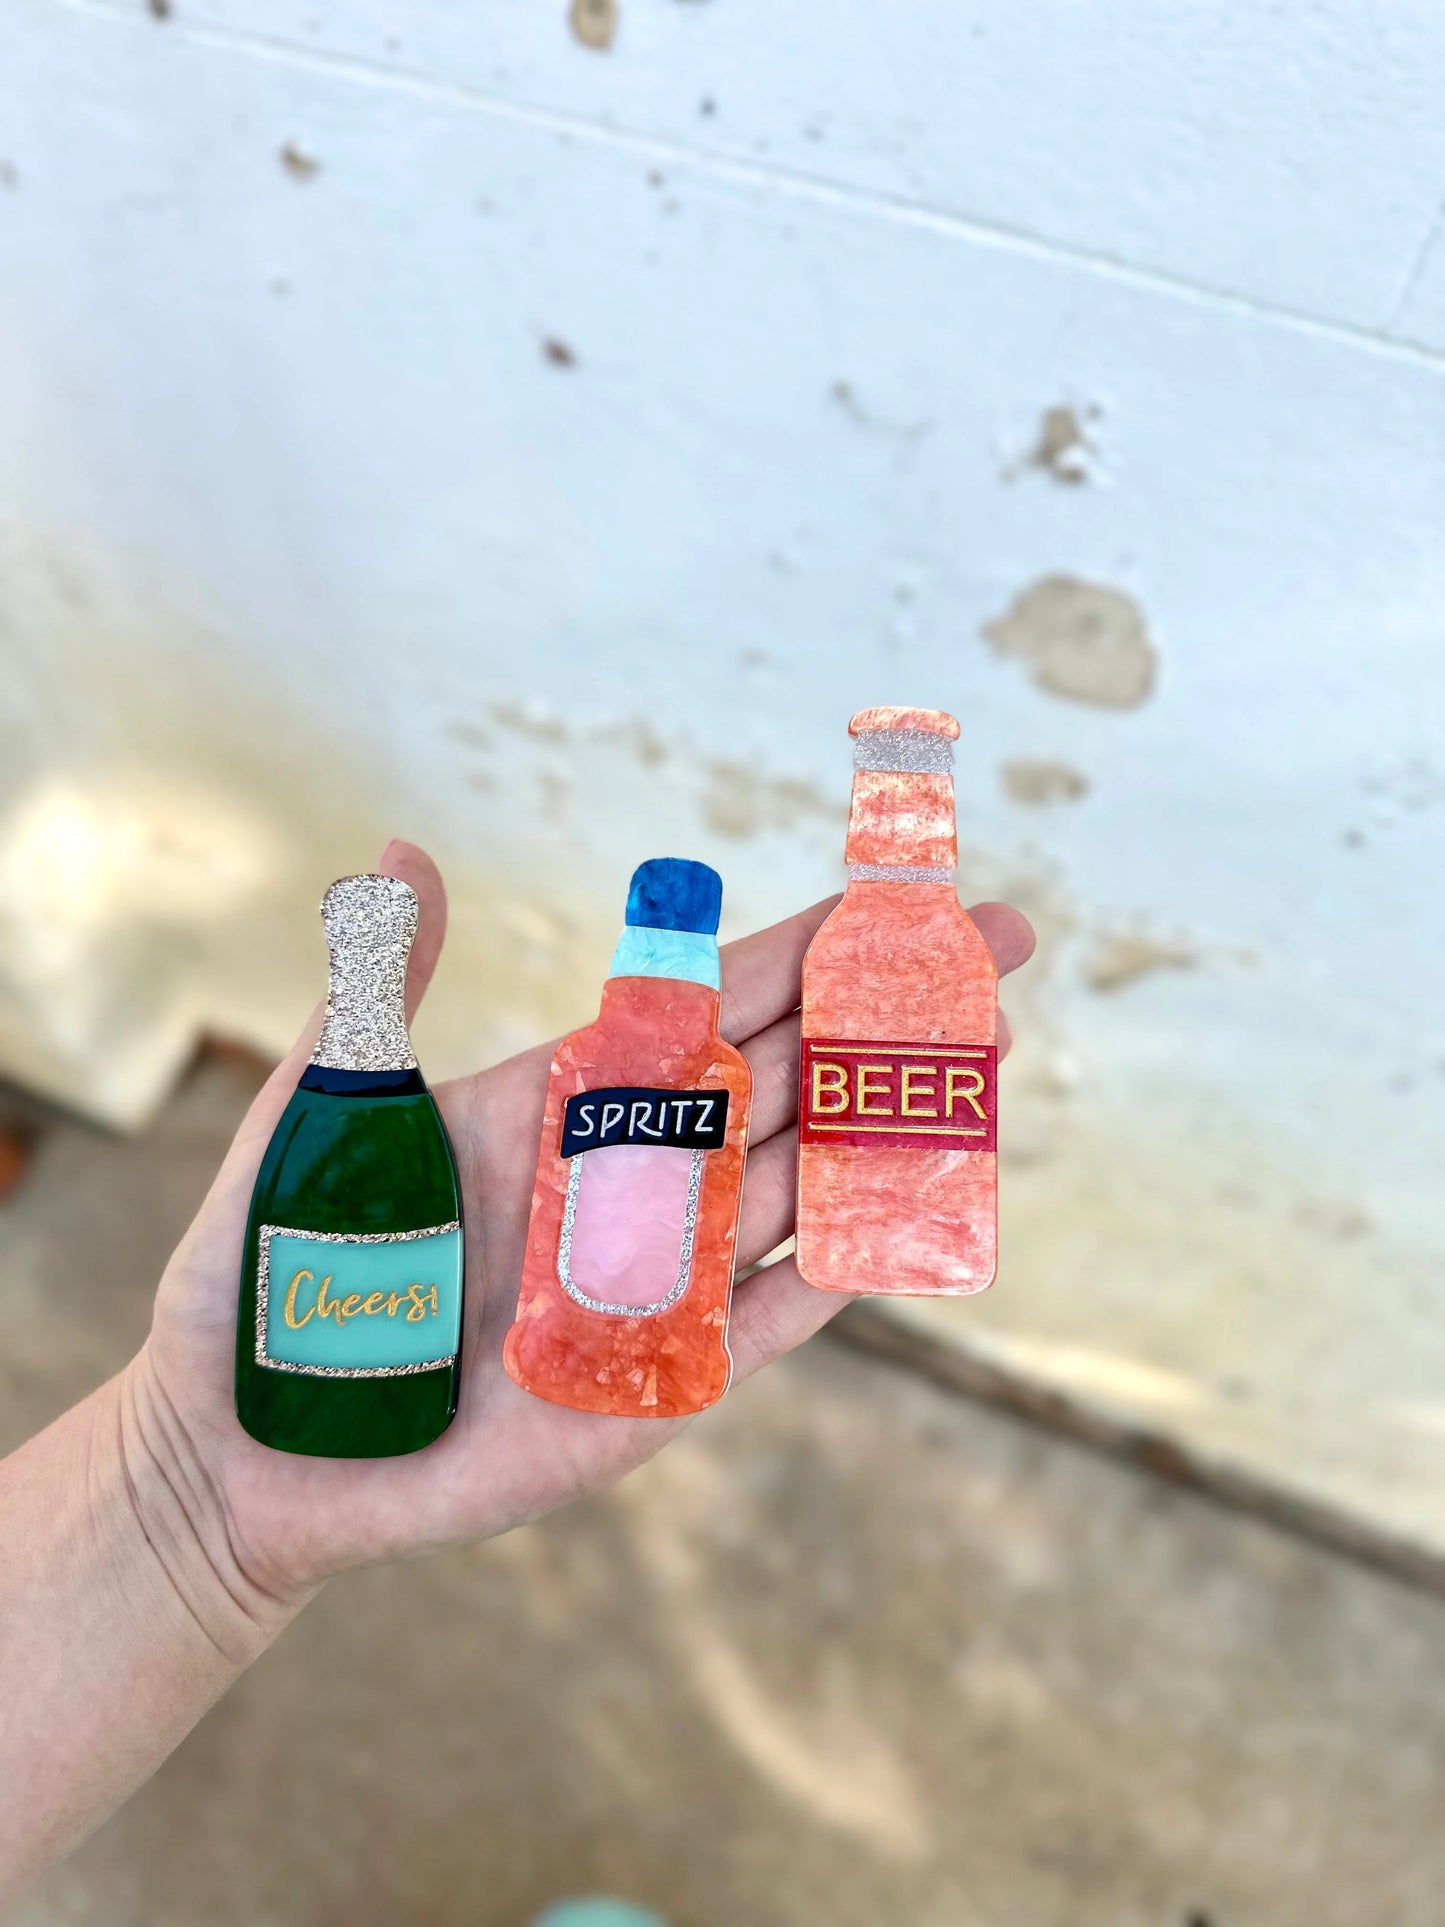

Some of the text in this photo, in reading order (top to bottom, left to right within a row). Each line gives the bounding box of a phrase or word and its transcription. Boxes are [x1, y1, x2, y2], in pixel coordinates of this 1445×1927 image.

[571, 1099, 715, 1139] SPRITZ
[811, 1062, 988, 1120] BEER
[284, 1268, 439, 1330] Cheers!
